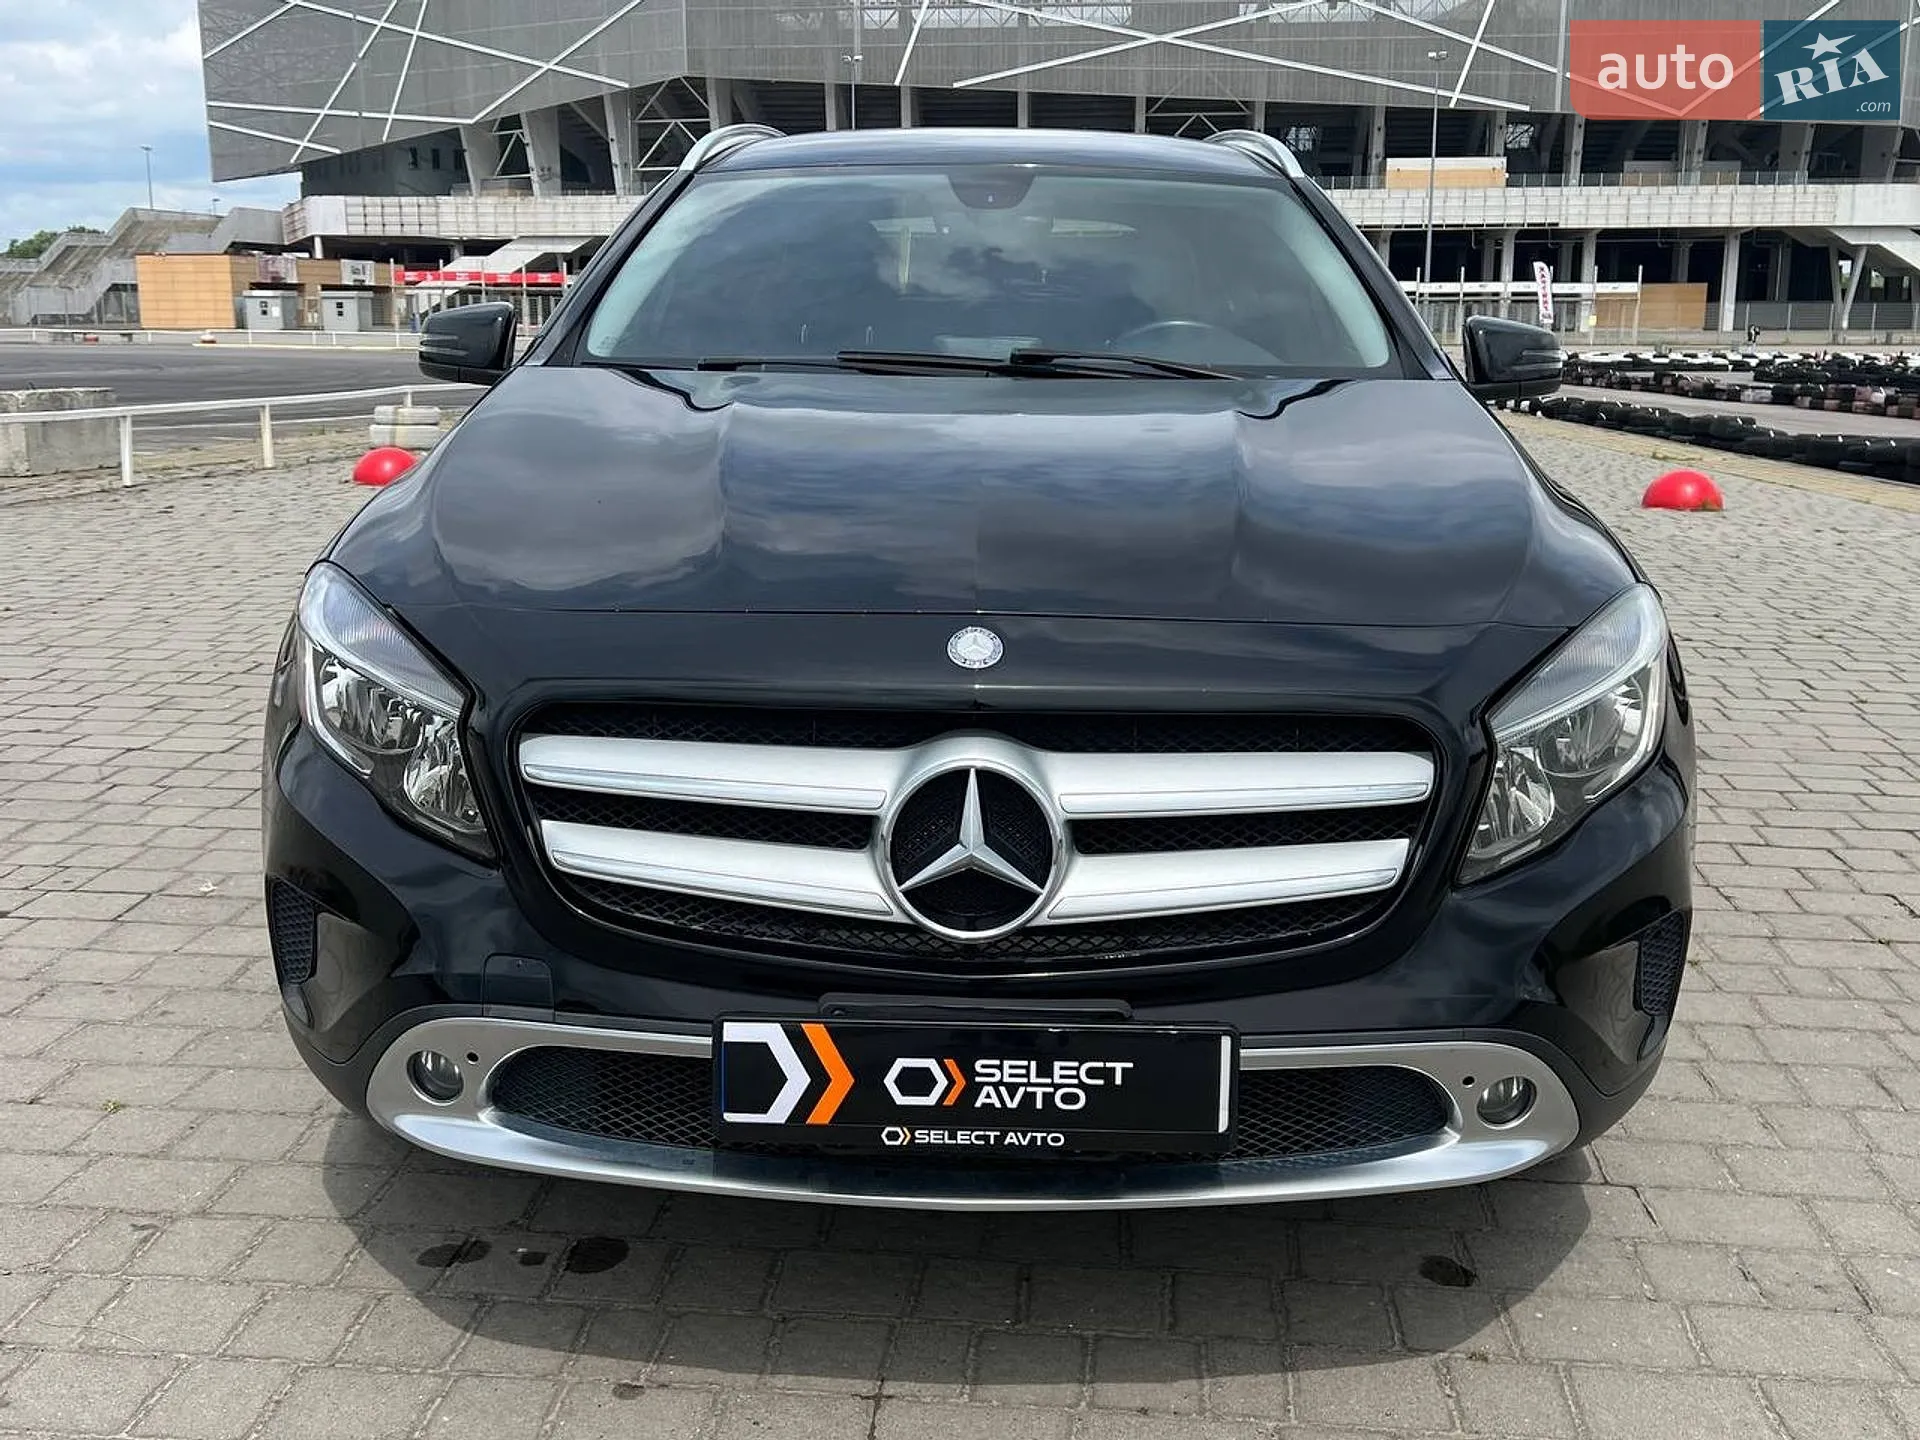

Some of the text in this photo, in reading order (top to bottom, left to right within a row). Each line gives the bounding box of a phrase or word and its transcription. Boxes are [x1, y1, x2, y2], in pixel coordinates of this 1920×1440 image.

[974, 1059, 1134, 1086] SELECT
[974, 1086, 1086, 1110] AVTO
[914, 1129, 1065, 1147] SELECT AVTO
